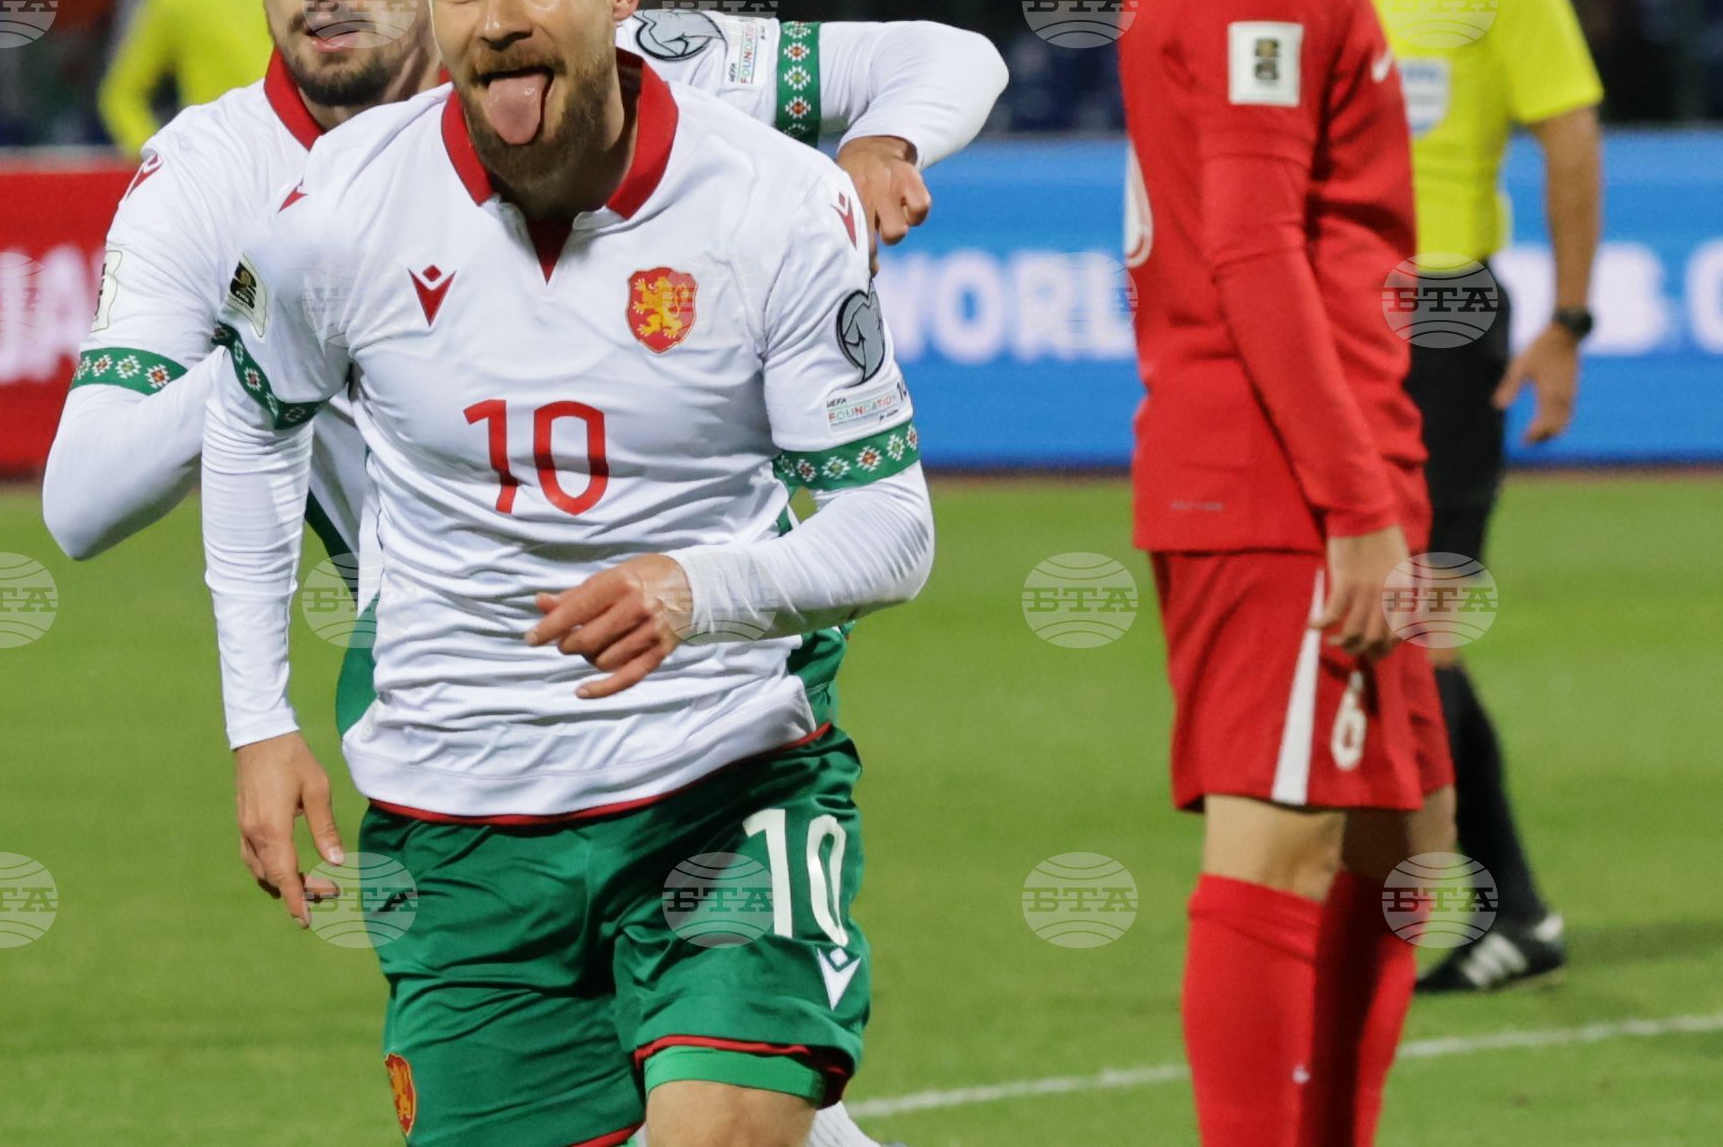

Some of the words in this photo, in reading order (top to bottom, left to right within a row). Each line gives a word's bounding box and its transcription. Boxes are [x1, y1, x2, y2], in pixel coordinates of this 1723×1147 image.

[874, 249, 1135, 361] WORL
[463, 398, 610, 515] 10
[1330, 671, 1367, 772] 6
[742, 808, 848, 947] 10
